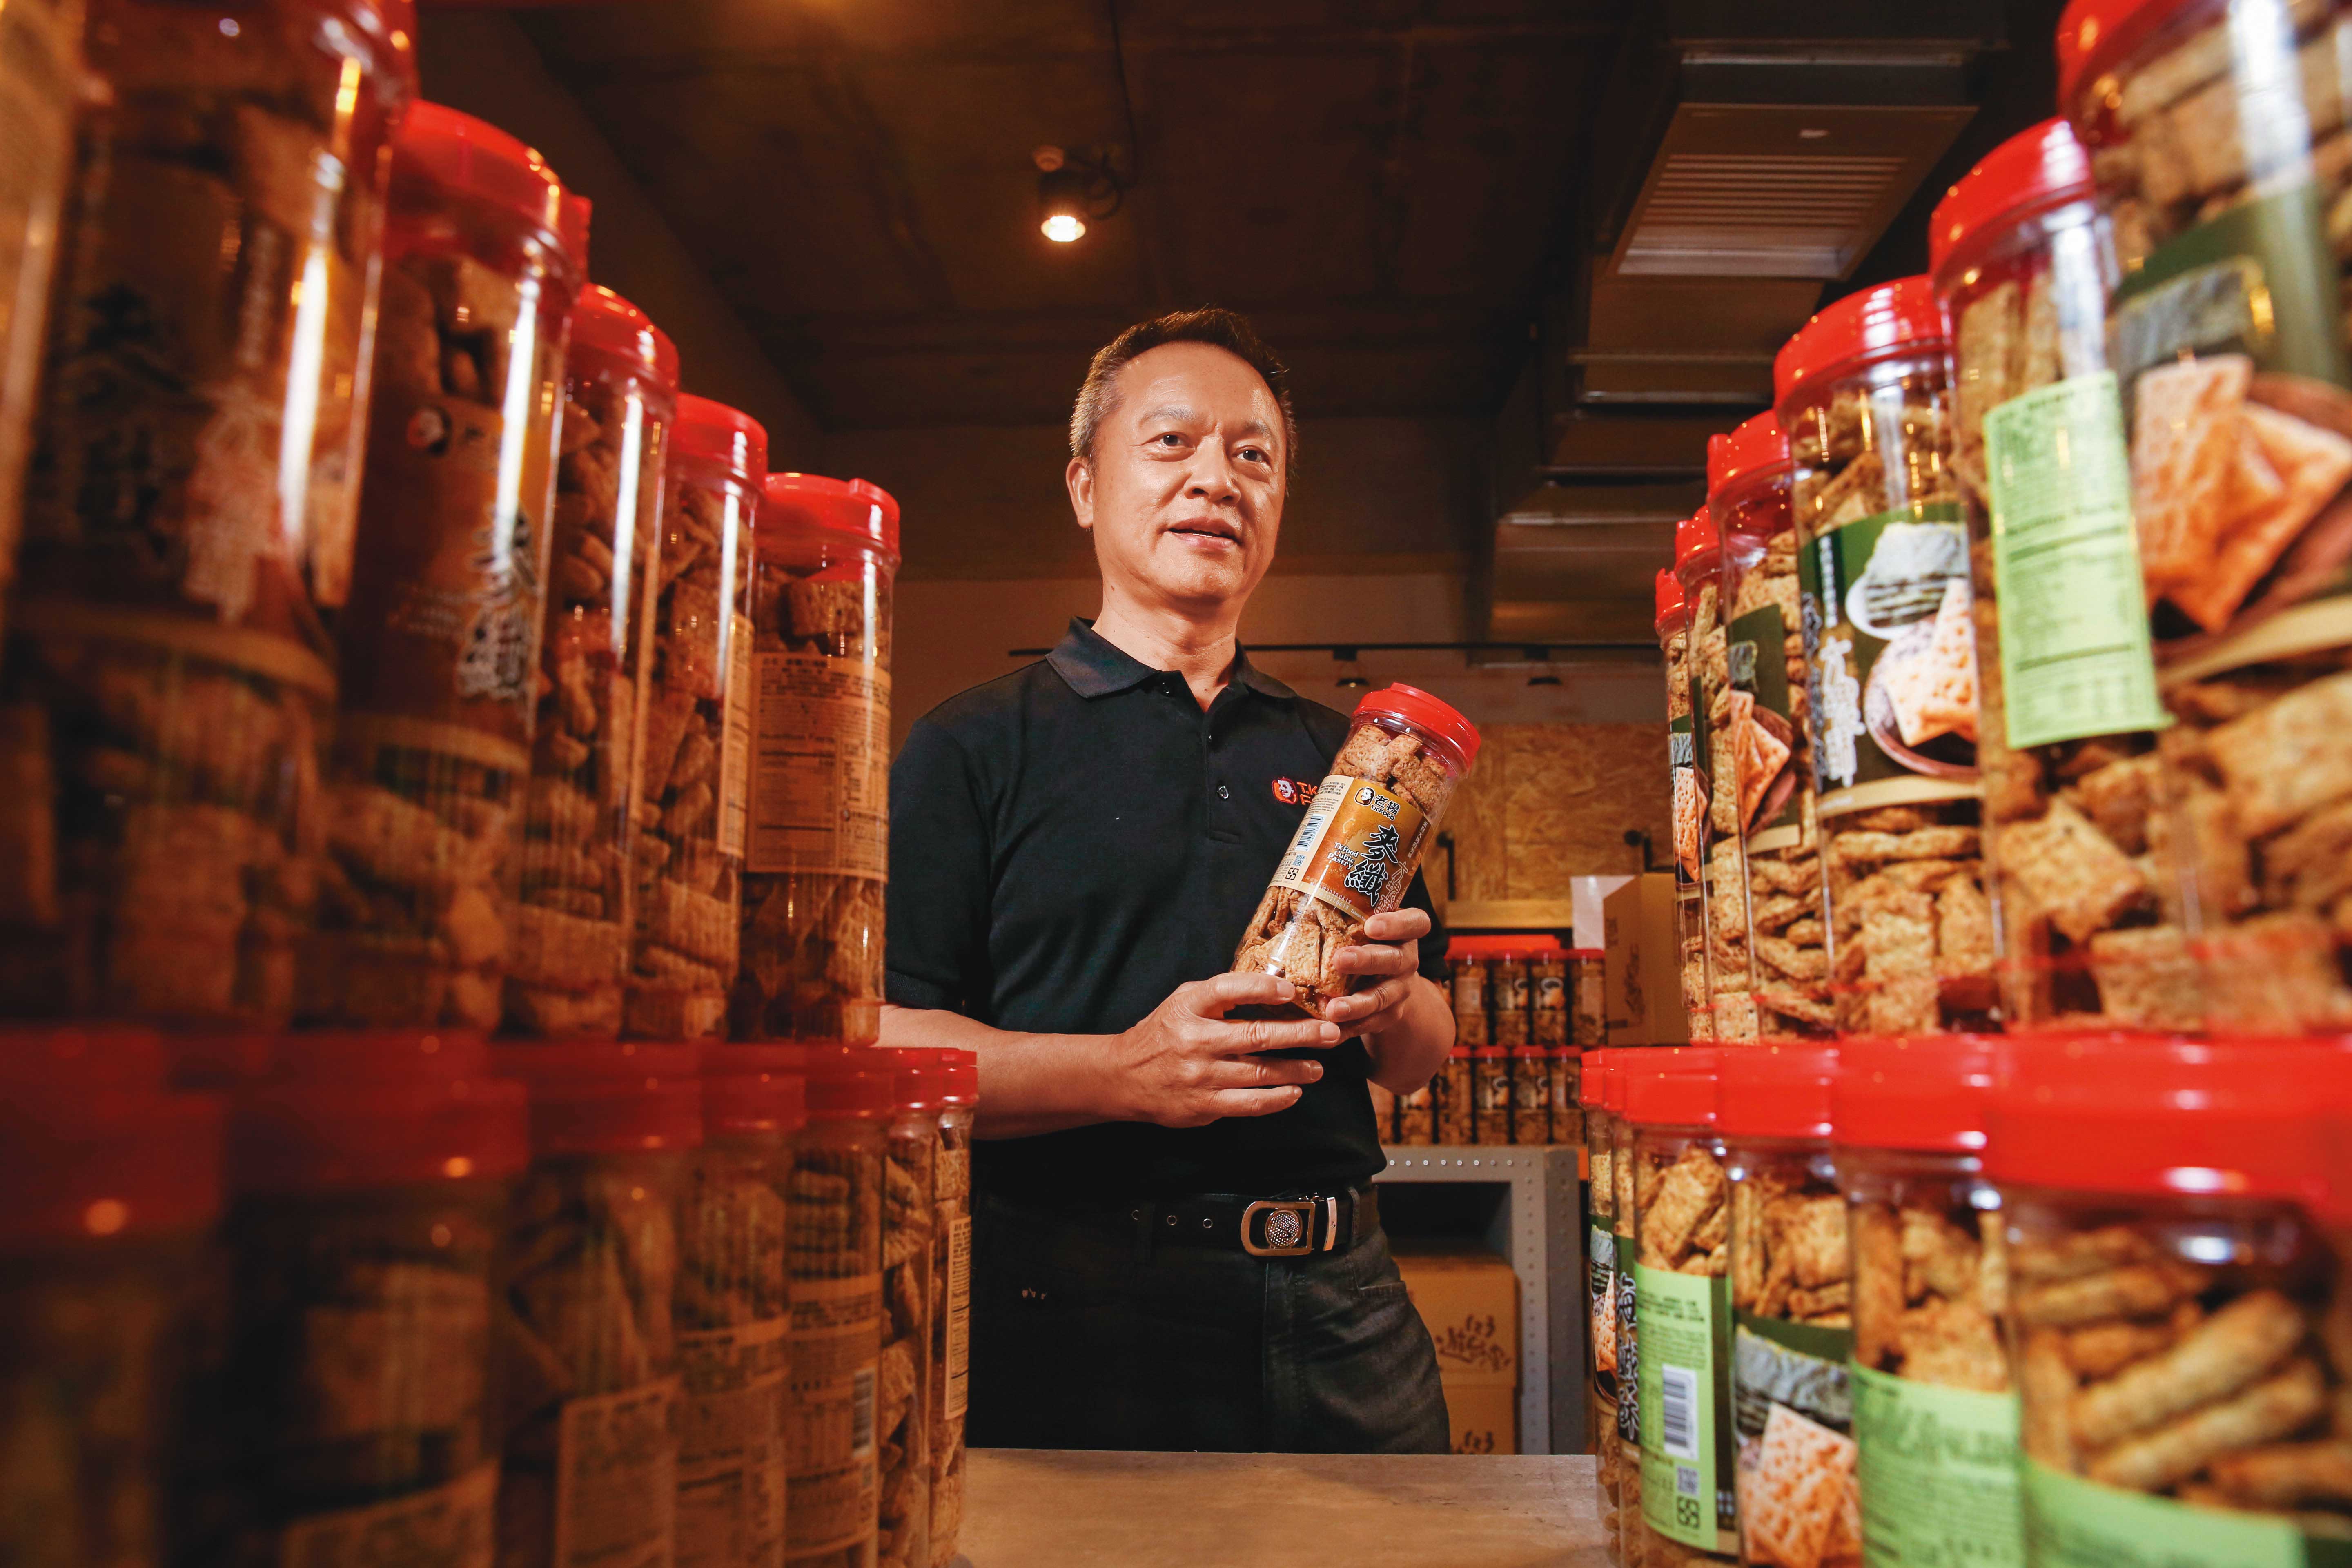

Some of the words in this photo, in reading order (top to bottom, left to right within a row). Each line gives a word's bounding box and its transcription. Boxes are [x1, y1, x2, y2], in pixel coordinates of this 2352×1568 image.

[1375, 795, 1400, 815] 老楊
[1327, 852, 1354, 870] Pastry
[1334, 850, 1355, 864] Cubic
[1344, 824, 1399, 907] 麥纖
